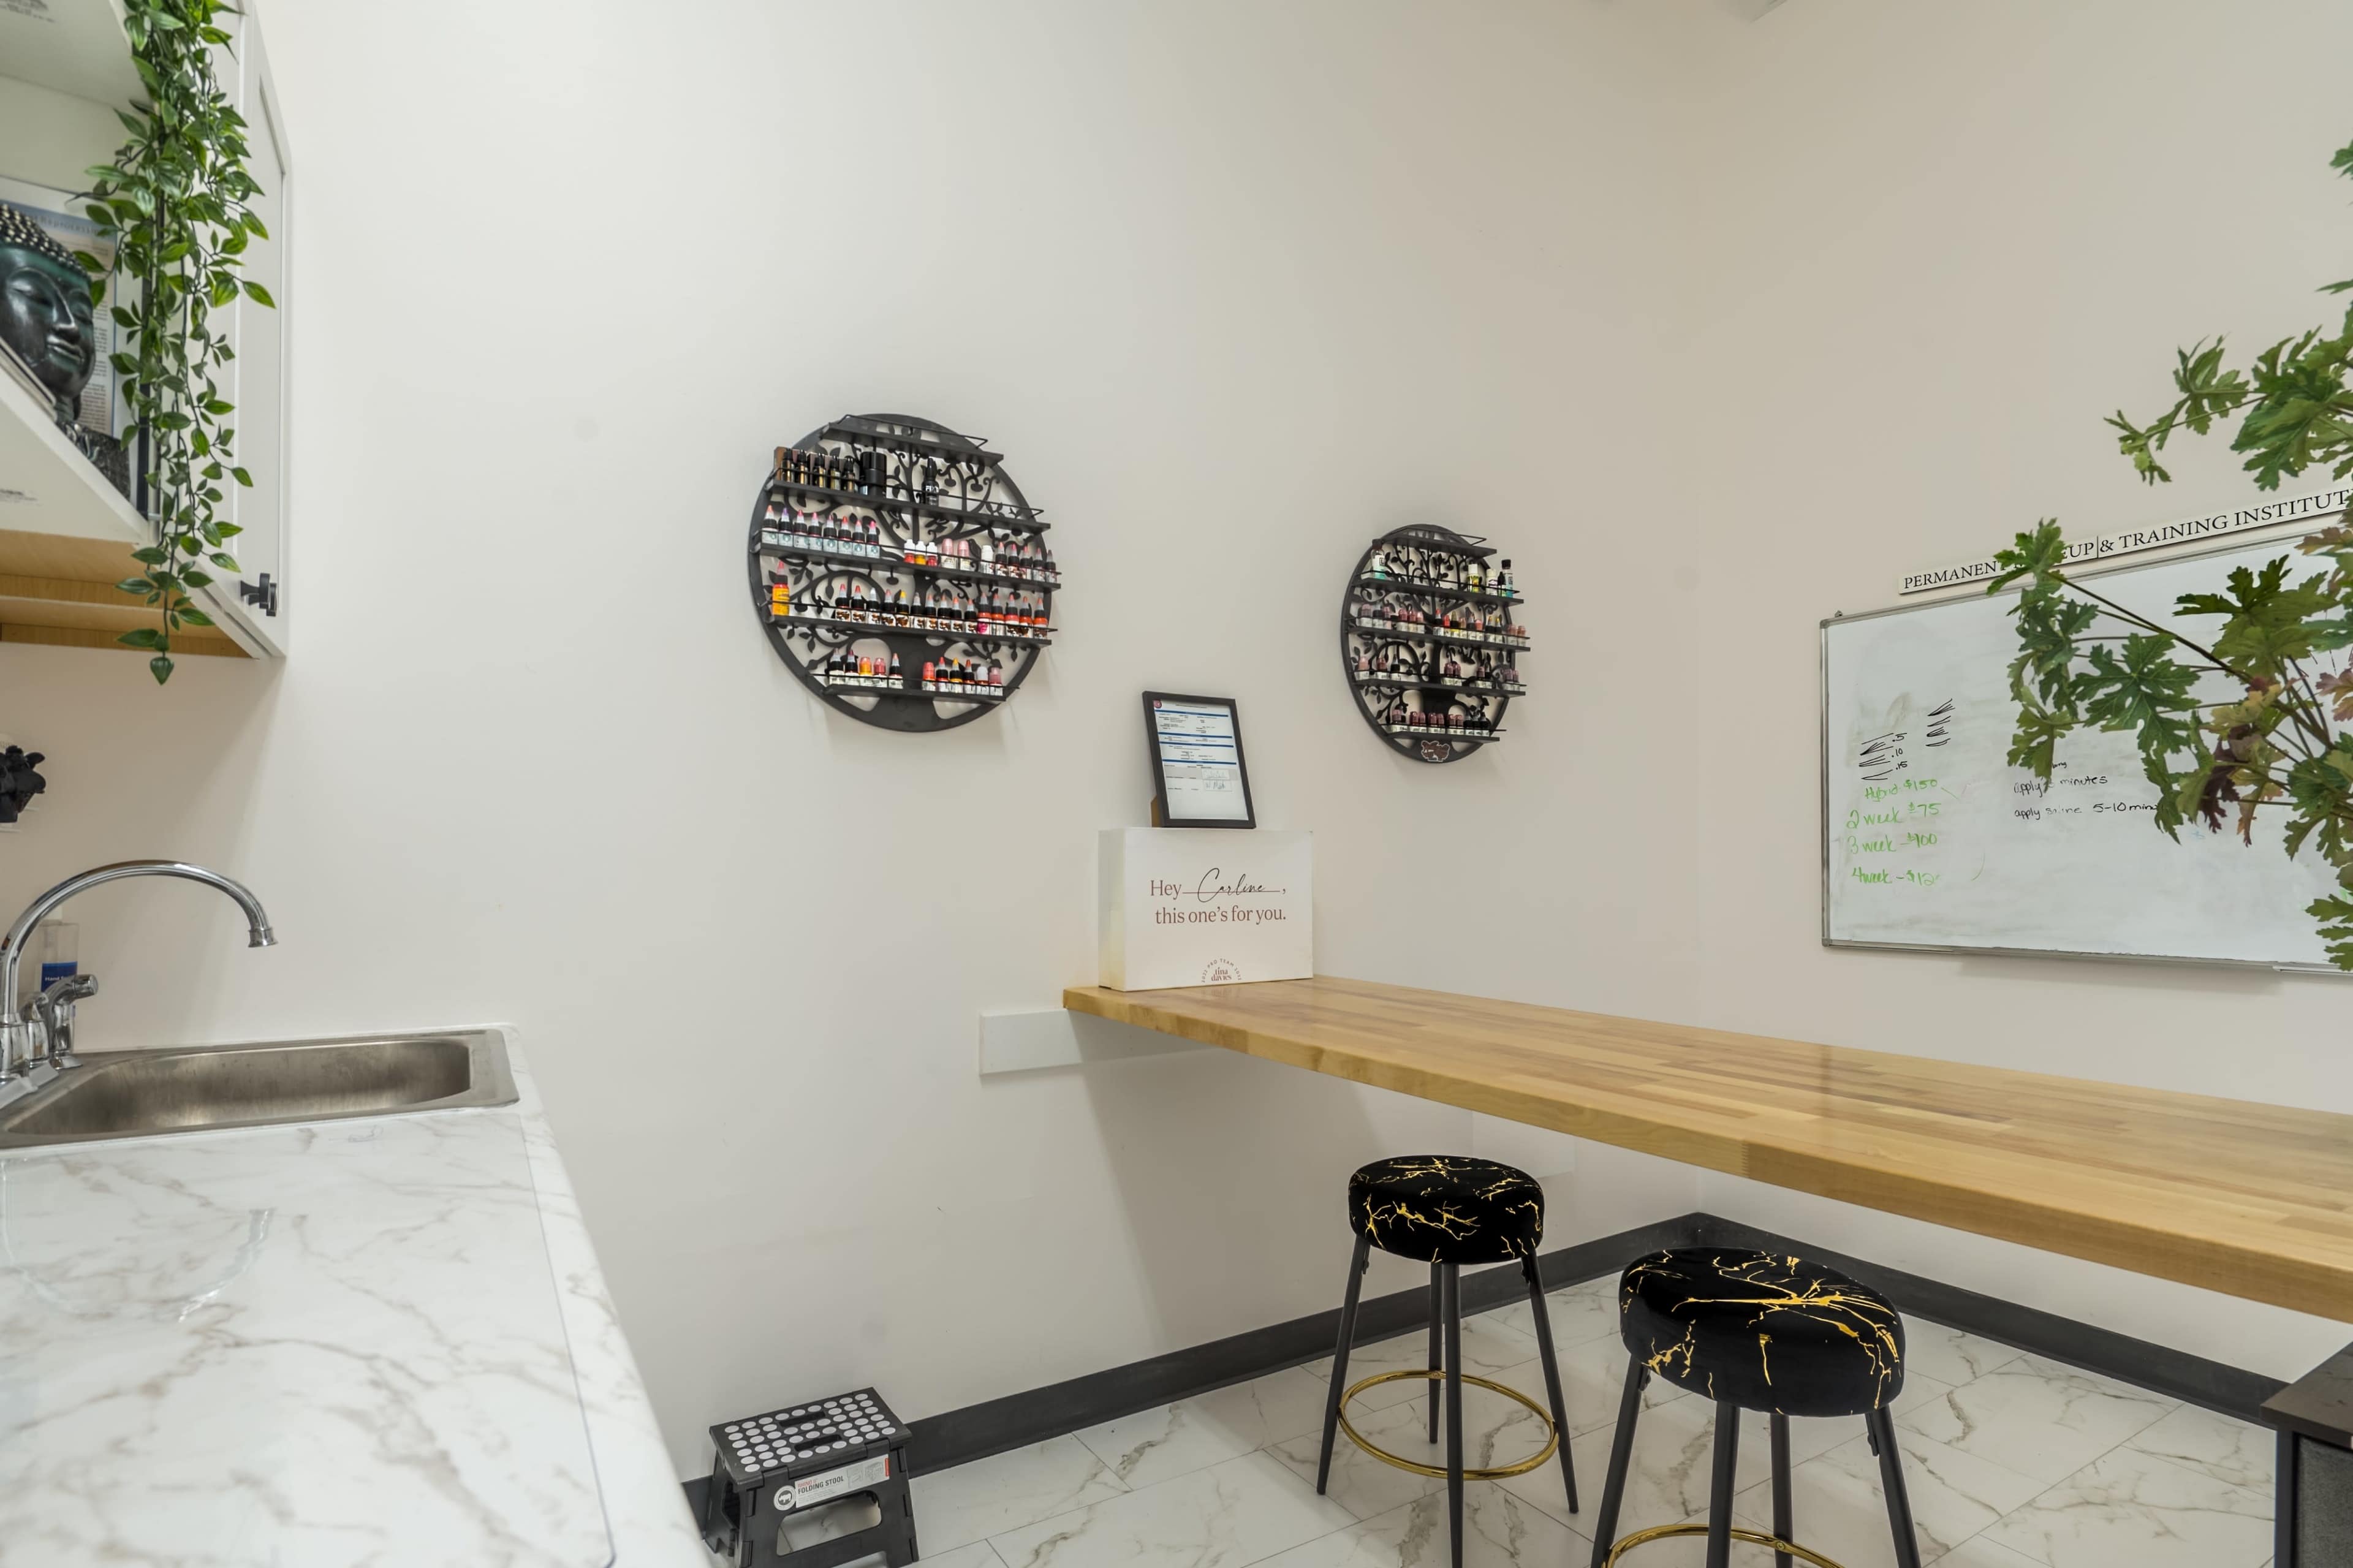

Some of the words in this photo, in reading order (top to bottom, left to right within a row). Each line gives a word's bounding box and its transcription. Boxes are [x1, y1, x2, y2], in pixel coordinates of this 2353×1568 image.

[2099, 539, 2115, 553] &
[2119, 515, 2229, 550] TRAINING
[2234, 488, 2353, 526] INSTITUT
[1892, 748, 1903, 758] .10
[1896, 761, 1908, 770] .15
[2059, 775, 2108, 786] minutes
[1846, 809, 1860, 828] 2
[1863, 806, 1903, 825] week
[2014, 808, 2041, 820] apply
[2093, 801, 2126, 812] 5-10
[1847, 835, 1859, 854] 3
[1862, 833, 1896, 852] week
[1906, 869, 1941, 887] $12
[1150, 879, 1182, 900] Hey
[1156, 907, 1184, 924] this
[1188, 906, 1228, 923] one’s
[1231, 904, 1253, 922] for
[1256, 908, 1286, 925] you.
[1215, 966, 1229, 975] tina
[1219, 958, 1235, 967] TEAM
[1211, 973, 1232, 982] davies
[798, 1482, 824, 1495] FOLDING
[825, 1475, 844, 1487] STOOL
